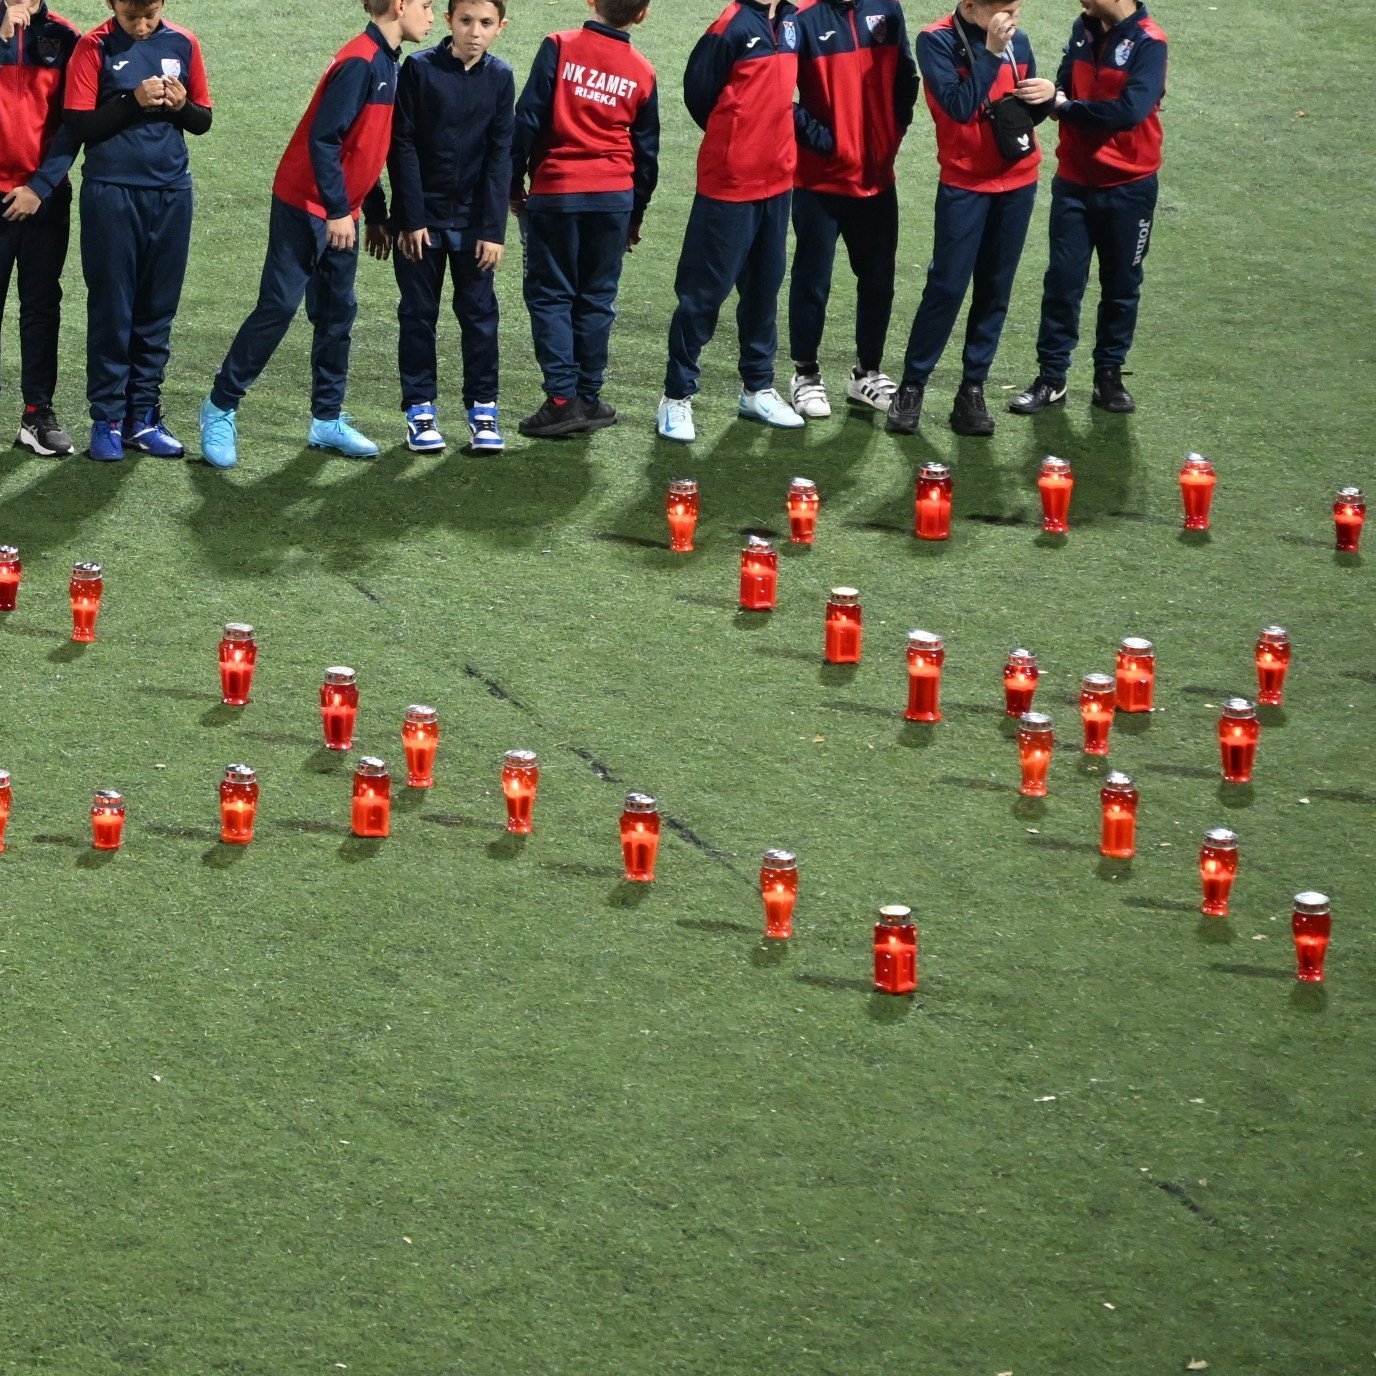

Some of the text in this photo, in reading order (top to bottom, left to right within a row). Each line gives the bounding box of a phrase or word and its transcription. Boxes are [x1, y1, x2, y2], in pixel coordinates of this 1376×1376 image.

[562, 62, 638, 100] NK ZAMET
[574, 85, 617, 108] RIJEKA
